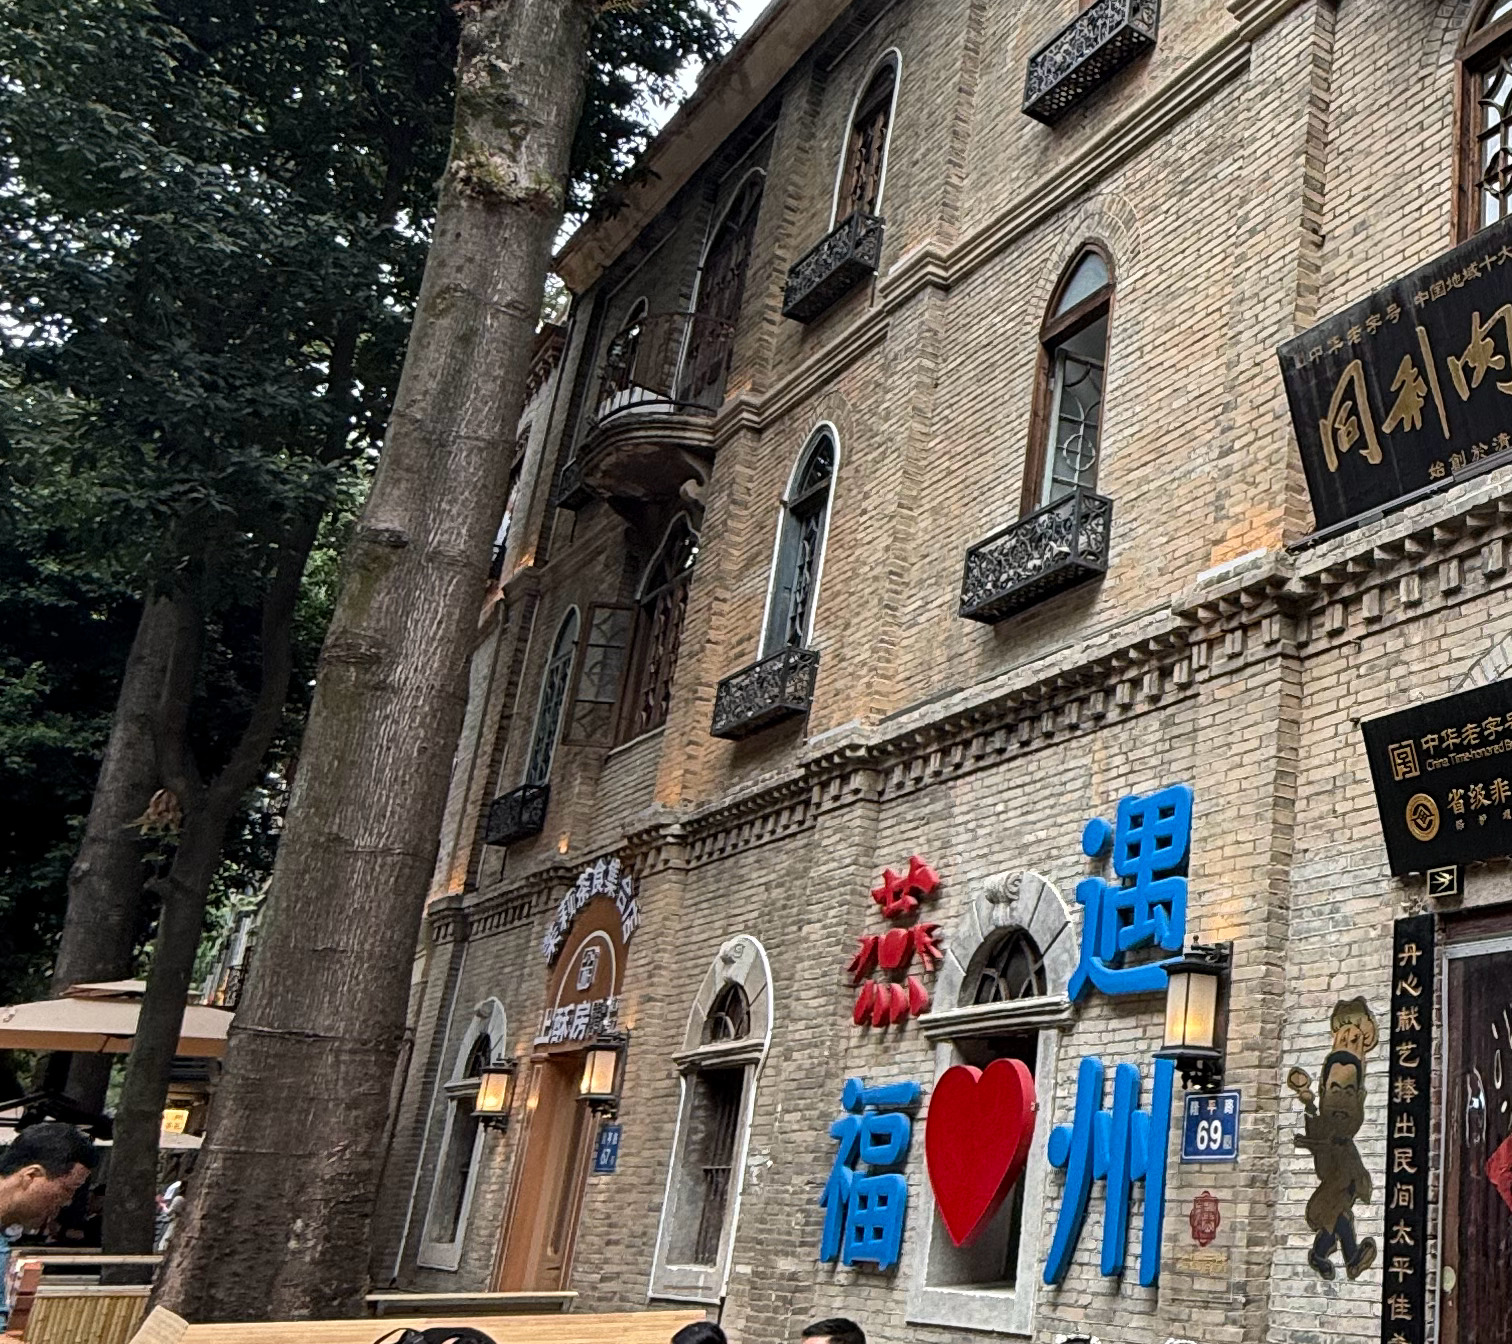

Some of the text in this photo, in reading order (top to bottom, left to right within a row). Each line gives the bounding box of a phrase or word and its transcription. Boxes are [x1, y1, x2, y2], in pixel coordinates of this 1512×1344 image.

[1067, 783, 1193, 1002] 遇
[820, 1057, 1175, 1287] 福 州
[1197, 1120, 1222, 1150] 69
